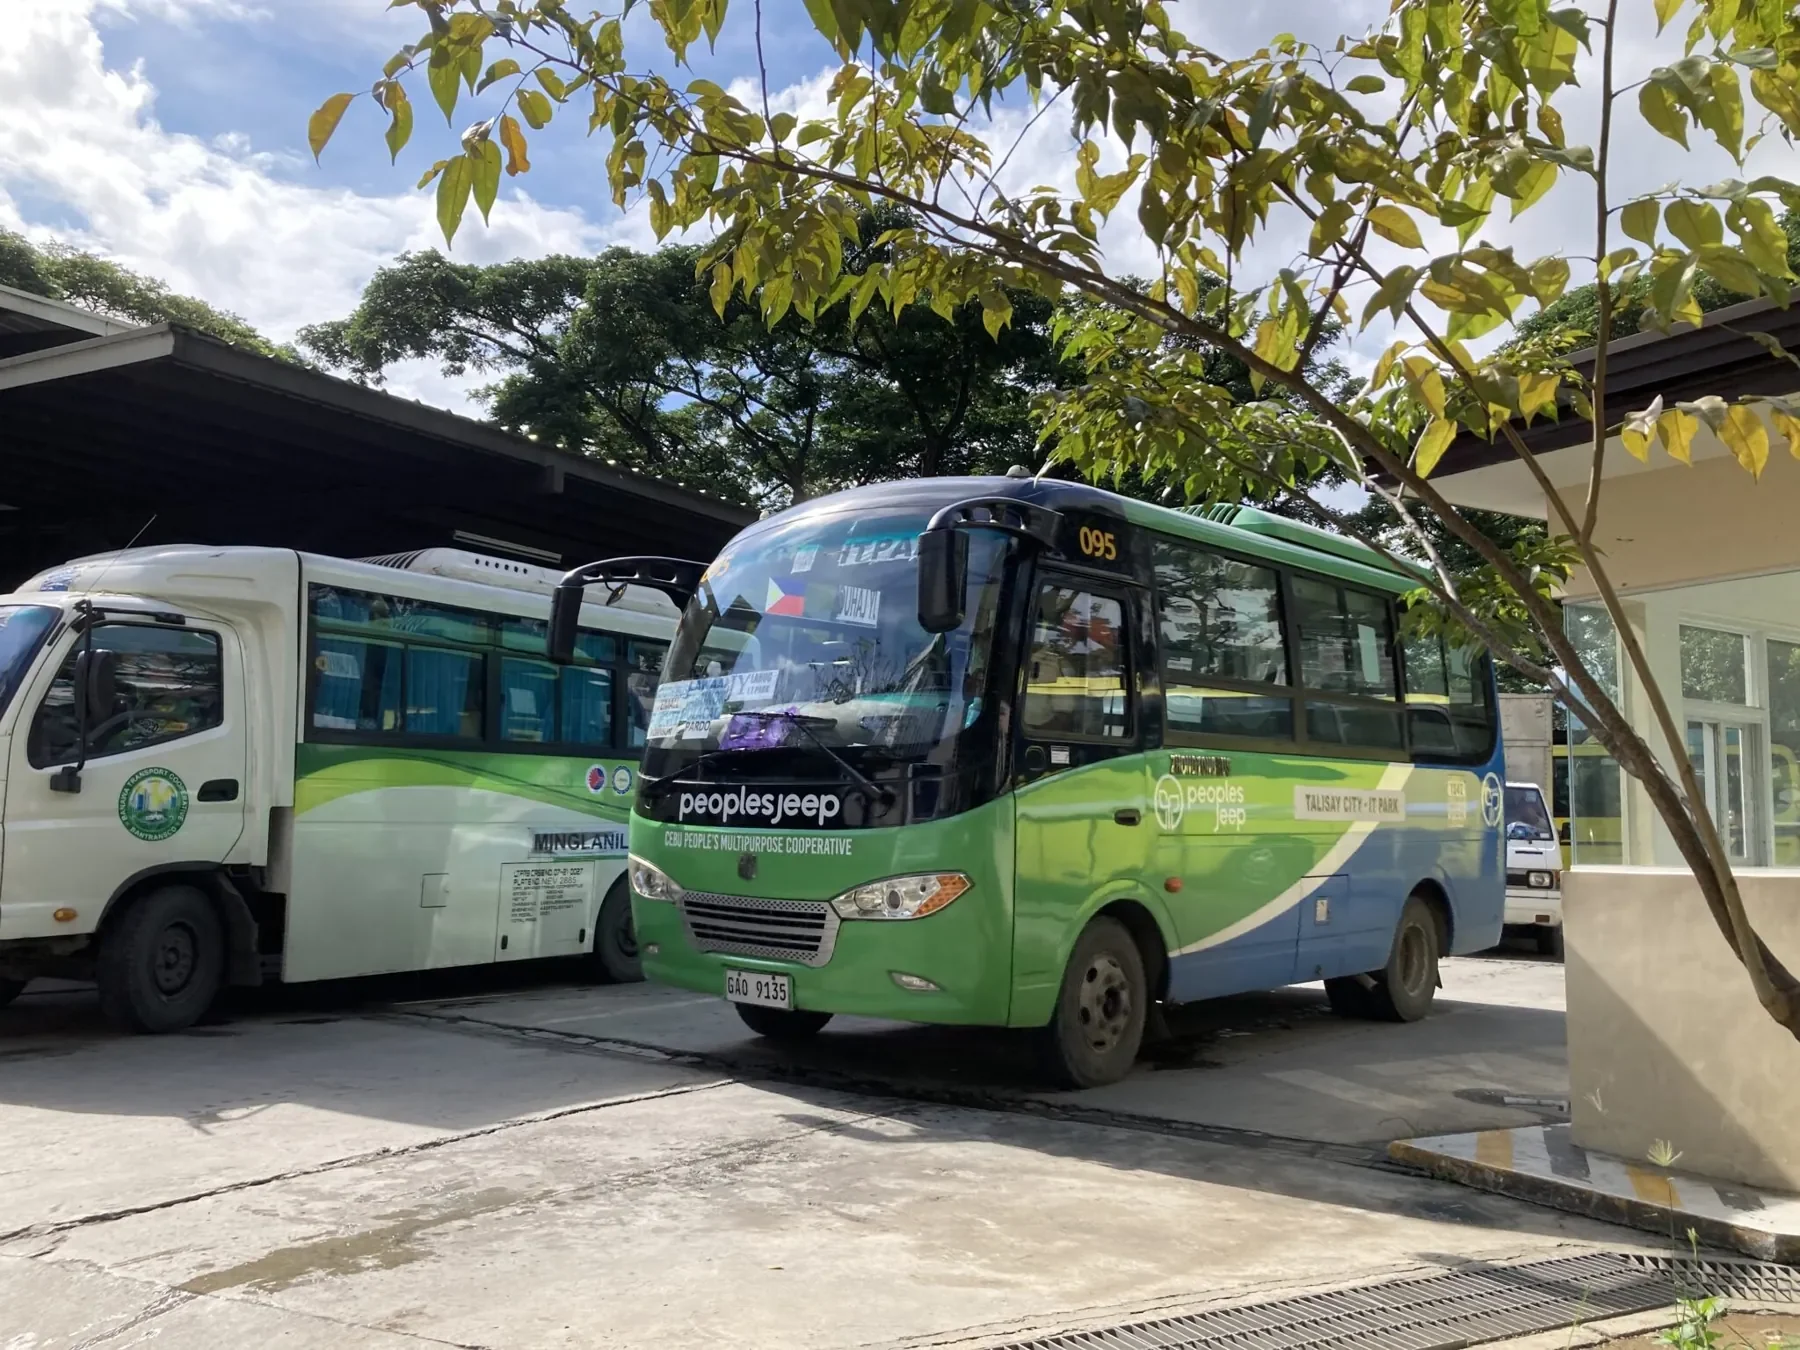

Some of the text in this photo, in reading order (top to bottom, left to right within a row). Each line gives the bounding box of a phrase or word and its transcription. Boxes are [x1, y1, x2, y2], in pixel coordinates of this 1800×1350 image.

[1080, 526, 1117, 560] 095
[685, 720, 711, 732] PARDO
[127, 768, 169, 787] TRANSPORT
[1187, 779, 1245, 810] peoples
[1305, 793, 1342, 813] TALISAY
[1343, 795, 1363, 813] CITY
[1378, 796, 1400, 814] PARK
[130, 826, 177, 841] BANTRANSCO
[533, 832, 629, 852] MINGLANIL
[664, 830, 853, 856] CEBU PEOPLE'S MULTIPURPOSE COOPERATIVE
[756, 980, 787, 1001] 9135
